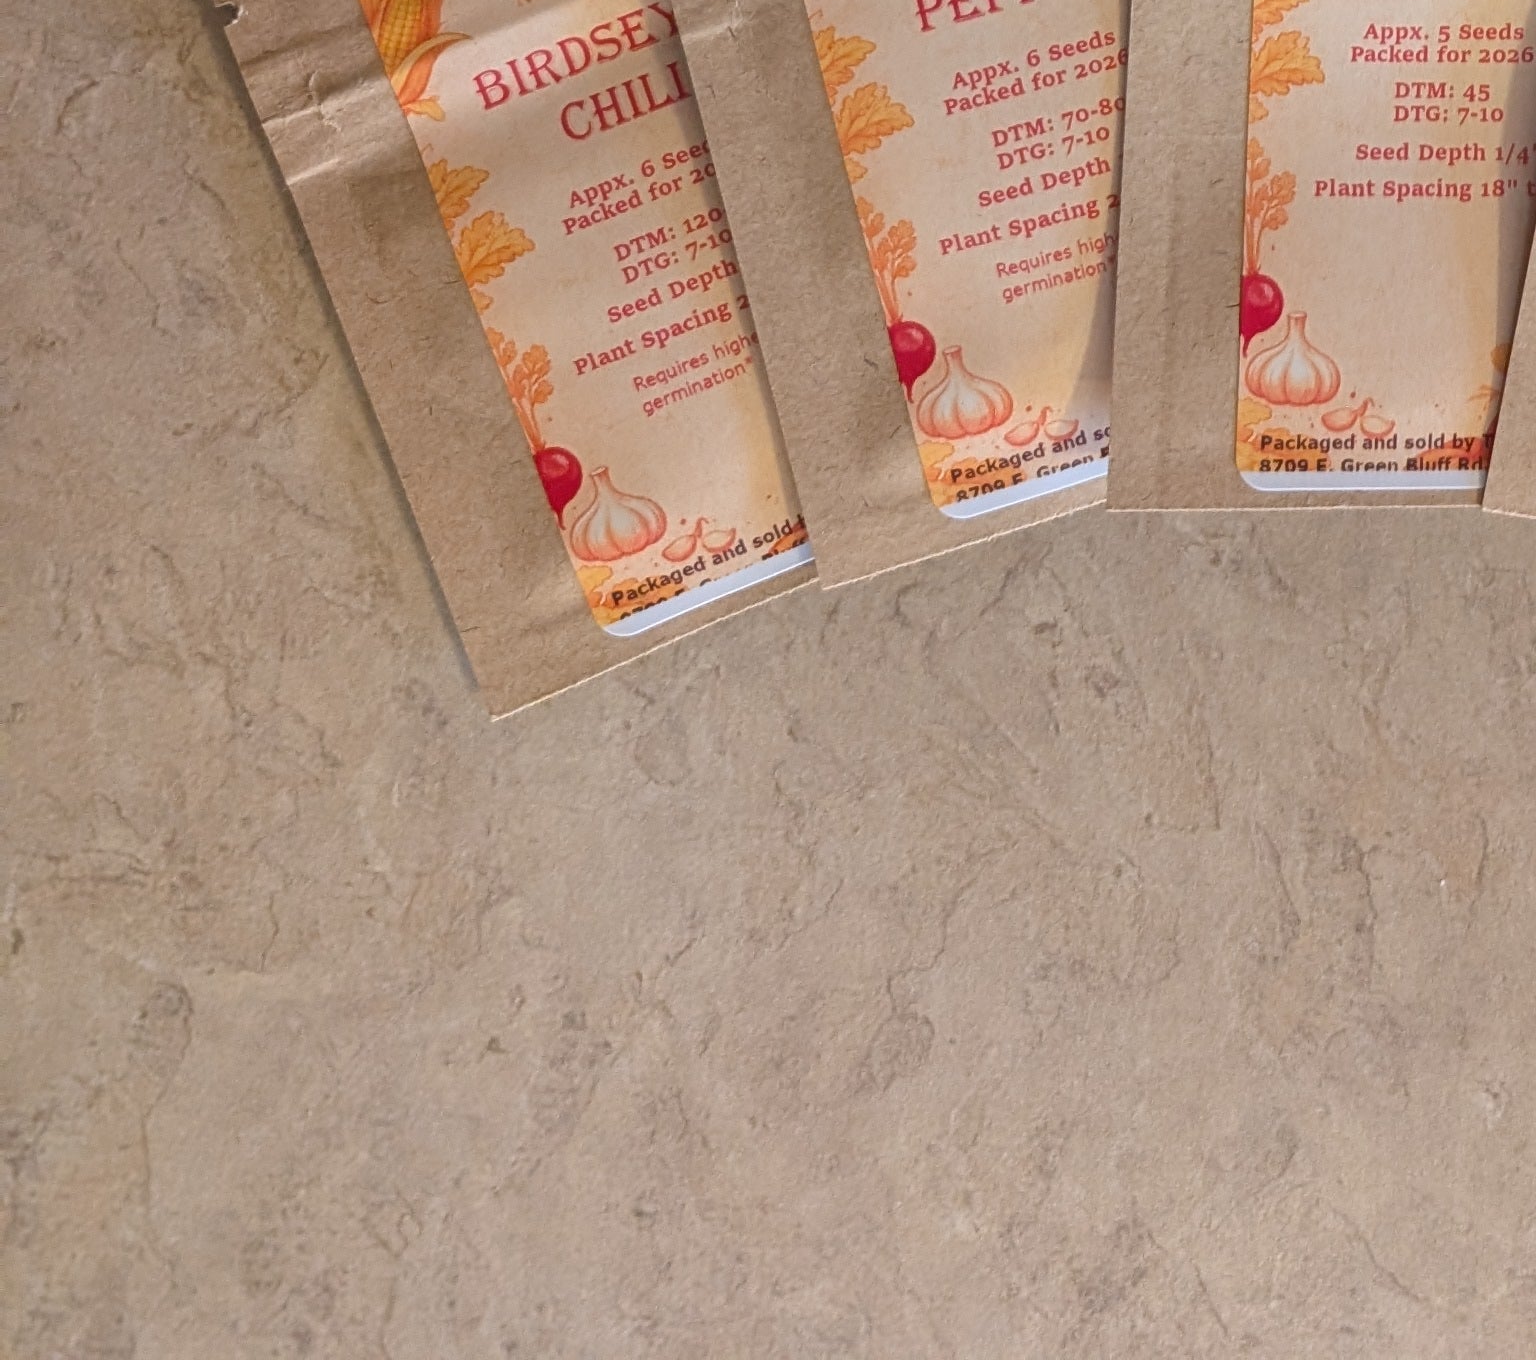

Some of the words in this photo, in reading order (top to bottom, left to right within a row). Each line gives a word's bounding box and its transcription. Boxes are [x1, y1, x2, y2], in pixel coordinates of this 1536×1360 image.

[472, 2, 679, 111] BIRDSEY
[1350, 44, 1429, 63] Packed
[1436, 44, 1472, 63] for
[1478, 46, 1534, 64] 2026
[1363, 23, 1429, 45] Appx.
[1437, 25, 1451, 44] 5
[1458, 22, 1524, 41] Seeds
[952, 60, 1020, 92] Appx.
[1026, 48, 1041, 68] 6
[1048, 30, 1116, 62] Seeds
[560, 61, 693, 141] CHILI
[1393, 105, 1449, 123] DTG:
[1457, 107, 1504, 126] 7-10
[1394, 81, 1454, 99] DTM:
[1462, 84, 1490, 103] 45
[996, 142, 1055, 171] DTG:
[1061, 126, 1110, 156] 7-10
[561, 189, 644, 236] Packed
[647, 176, 683, 202] for
[621, 251, 679, 285] DTG:
[684, 222, 735, 261] 7-10
